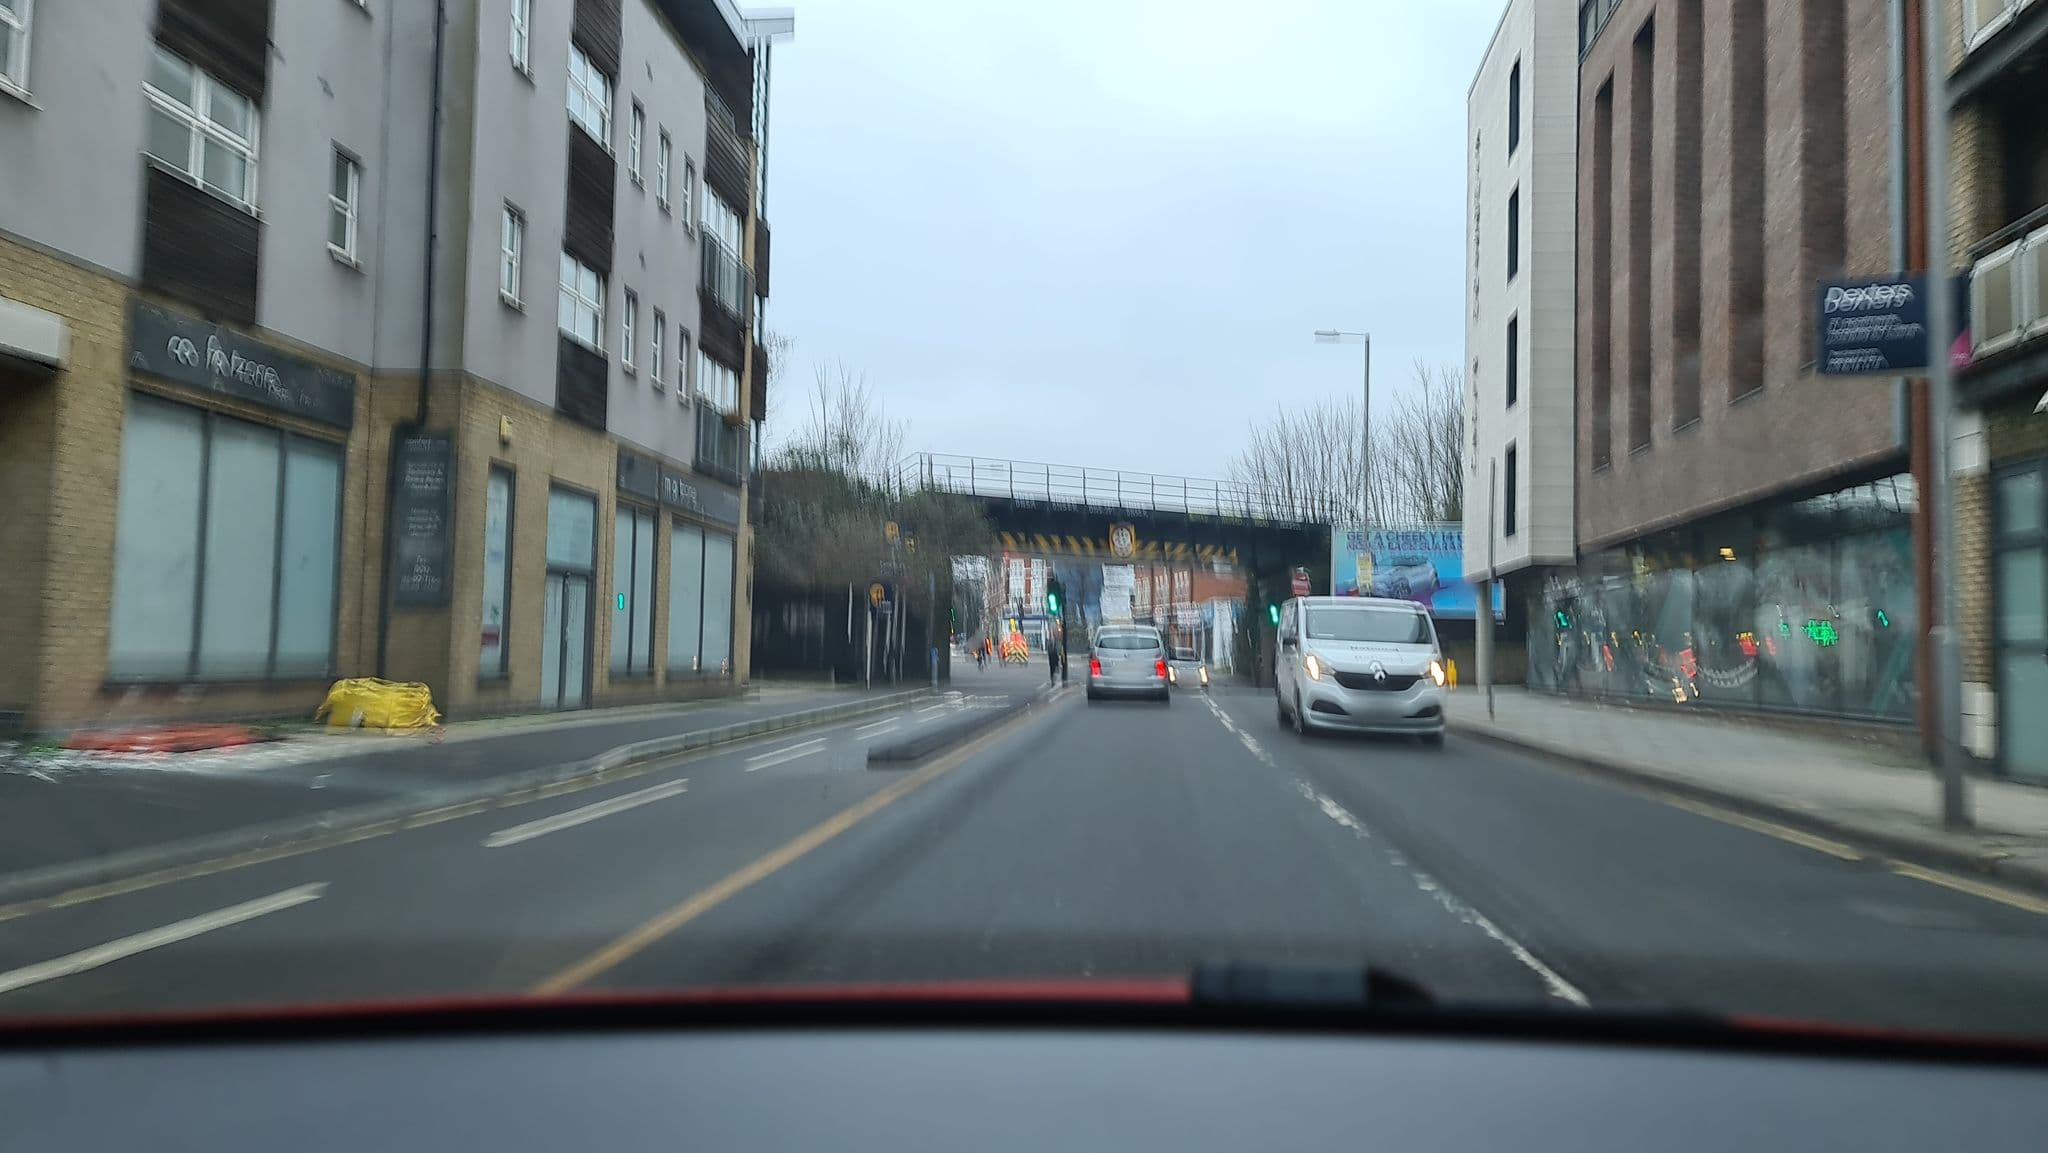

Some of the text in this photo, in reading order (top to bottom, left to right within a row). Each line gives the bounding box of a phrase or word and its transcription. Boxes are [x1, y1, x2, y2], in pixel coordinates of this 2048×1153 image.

[1824, 283, 1914, 314] Dexters
[1347, 531, 1370, 541] GET
[1386, 531, 1436, 543] CHEEKY
